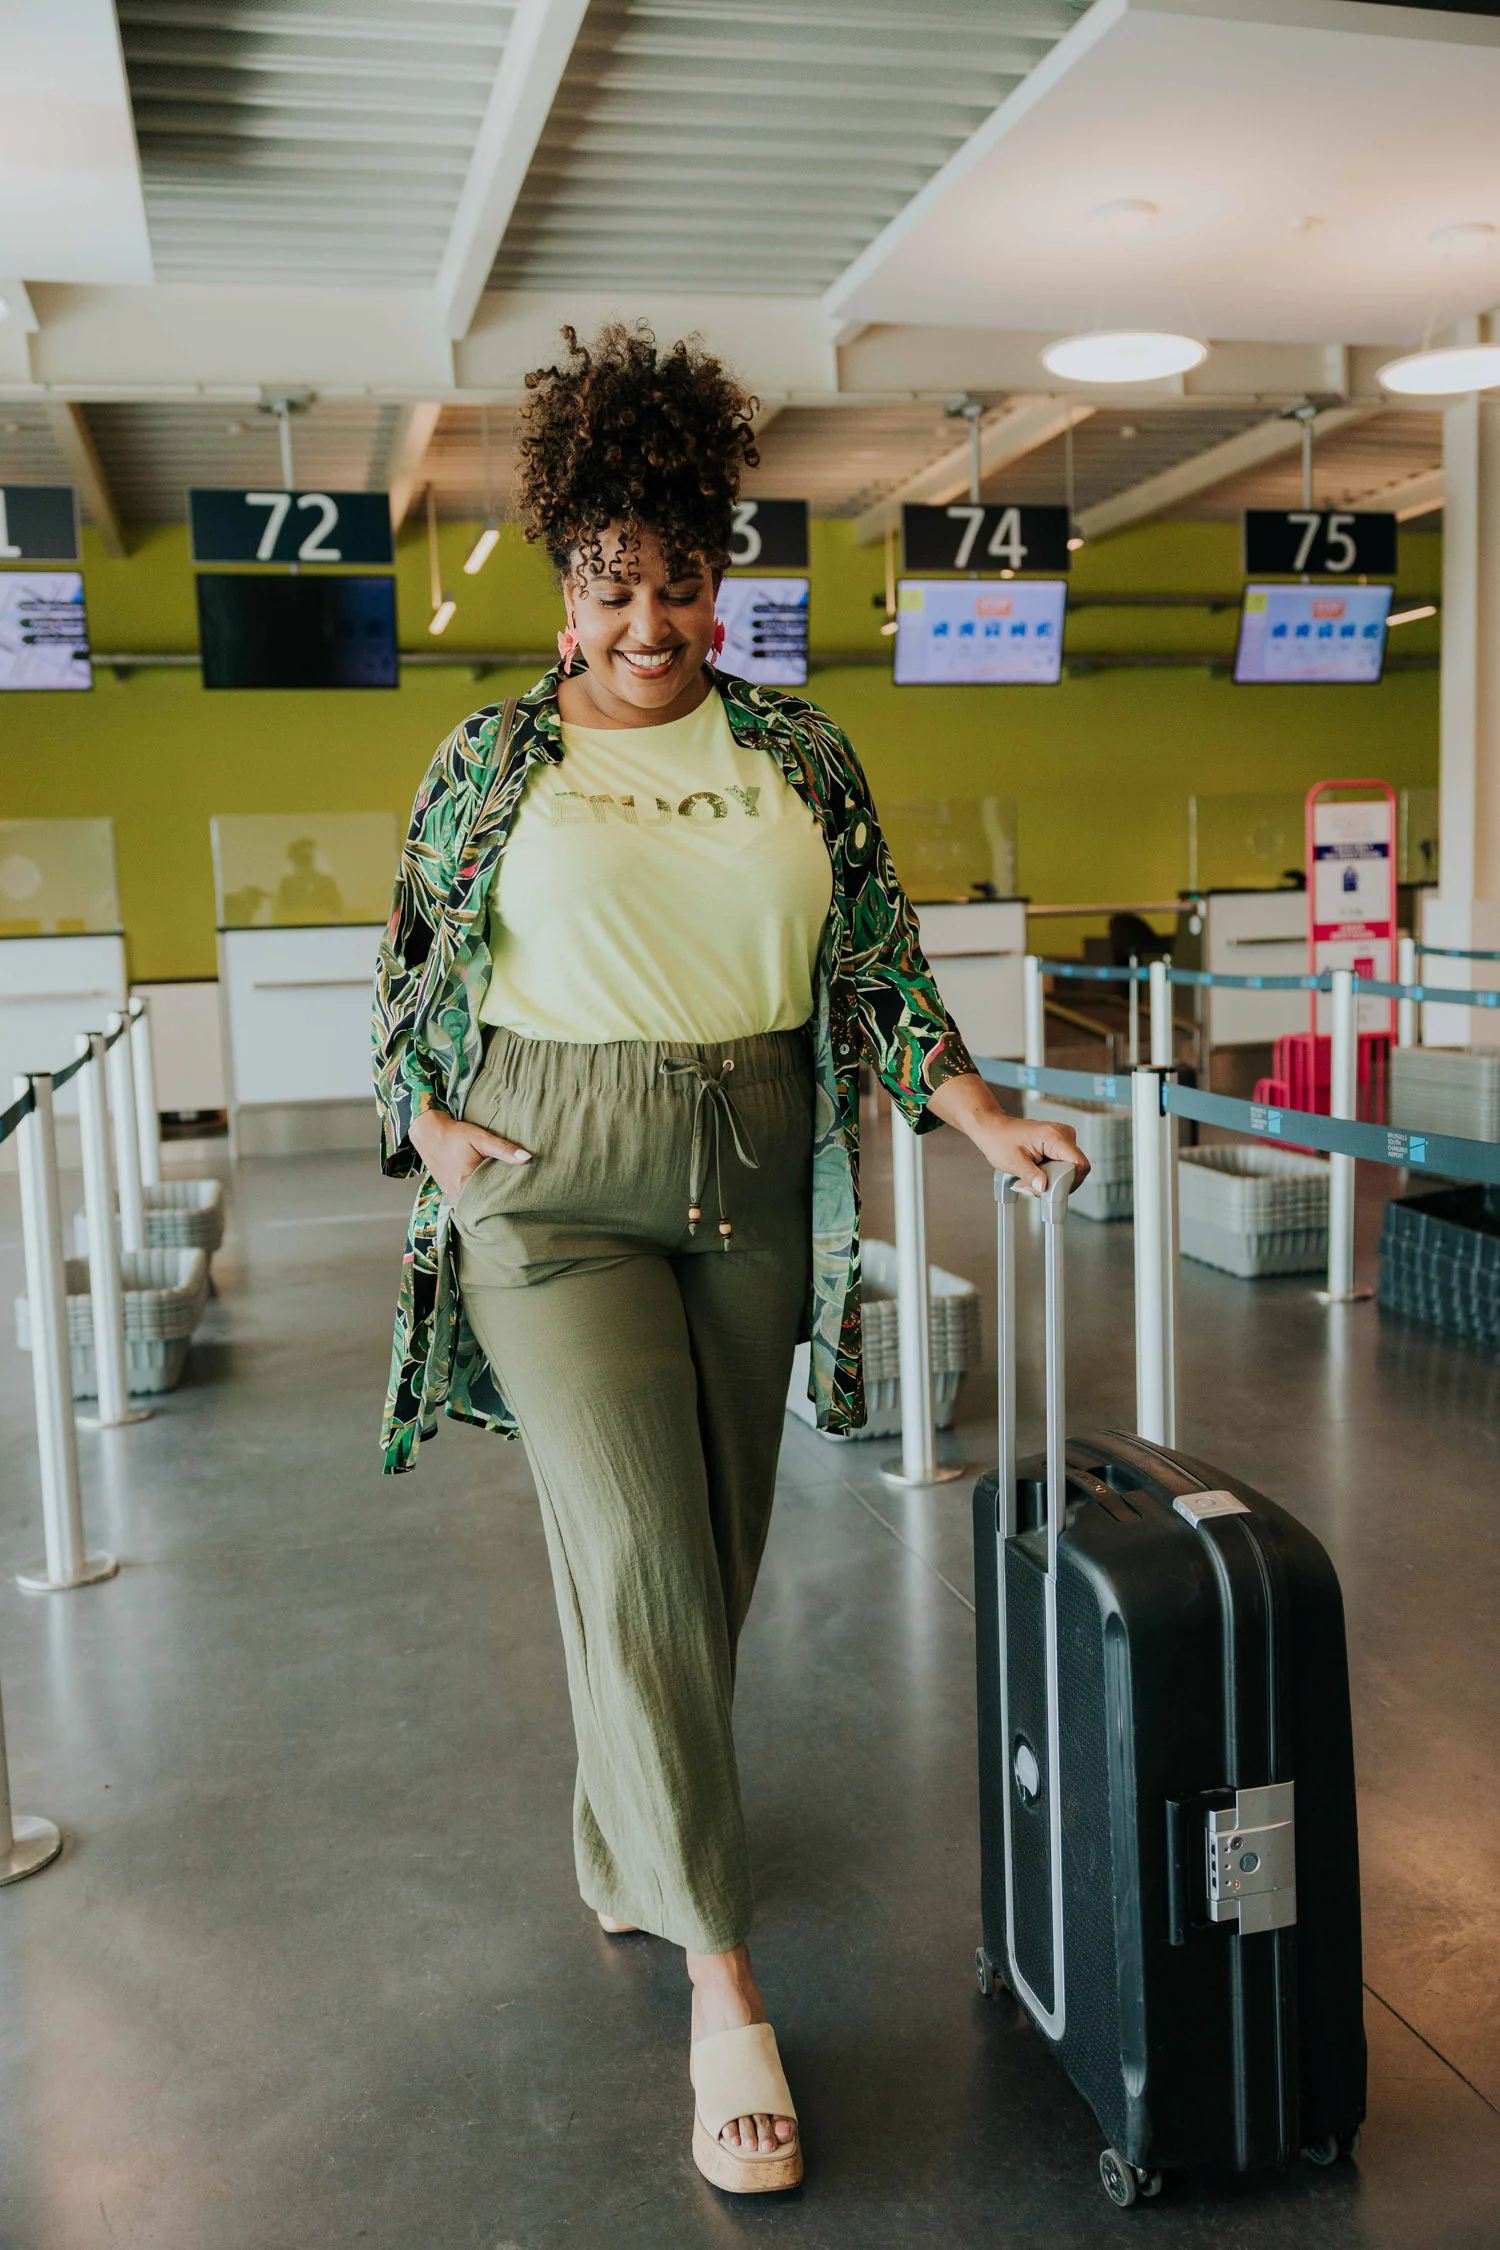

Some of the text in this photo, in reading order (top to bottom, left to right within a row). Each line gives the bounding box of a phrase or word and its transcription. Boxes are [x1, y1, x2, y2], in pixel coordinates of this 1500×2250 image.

[245, 493, 342, 561] 72
[731, 501, 762, 565] 3
[946, 506, 1028, 569] 74
[1287, 513, 1357, 573] 75
